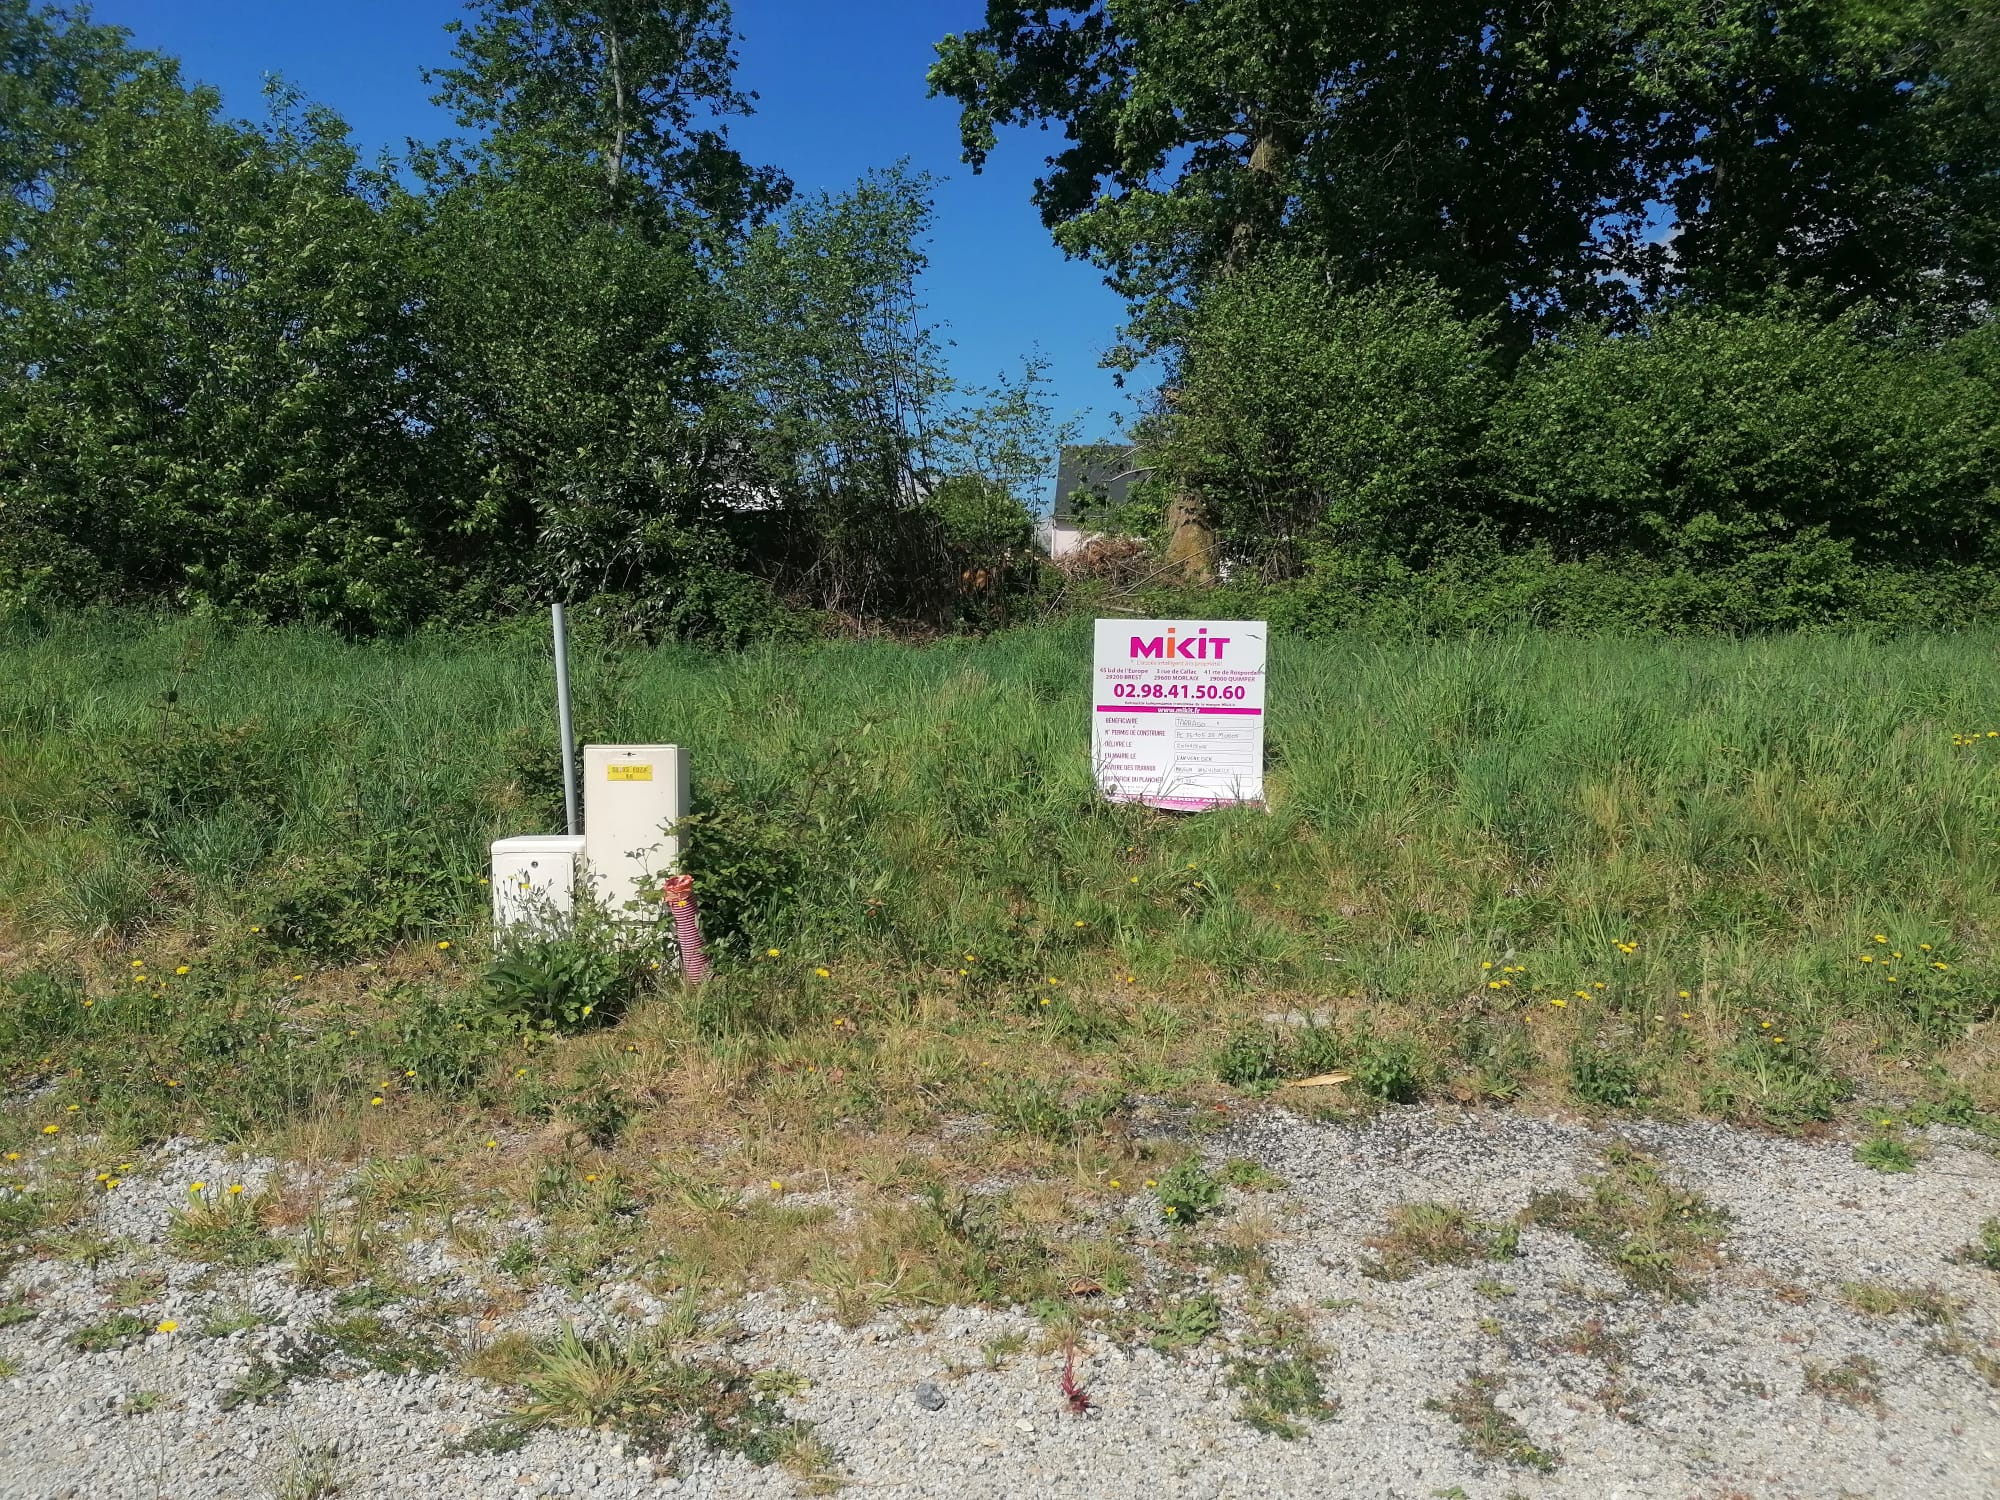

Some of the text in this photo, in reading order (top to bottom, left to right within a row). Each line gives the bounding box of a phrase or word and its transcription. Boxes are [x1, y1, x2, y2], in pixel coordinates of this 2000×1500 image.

[1125, 668, 1149, 676] l'Europe
[1113, 684, 1246, 700] 02.98.41.50.60
[1136, 729, 1166, 737] CONSTRUIRE
[1126, 740, 1133, 748] LE
